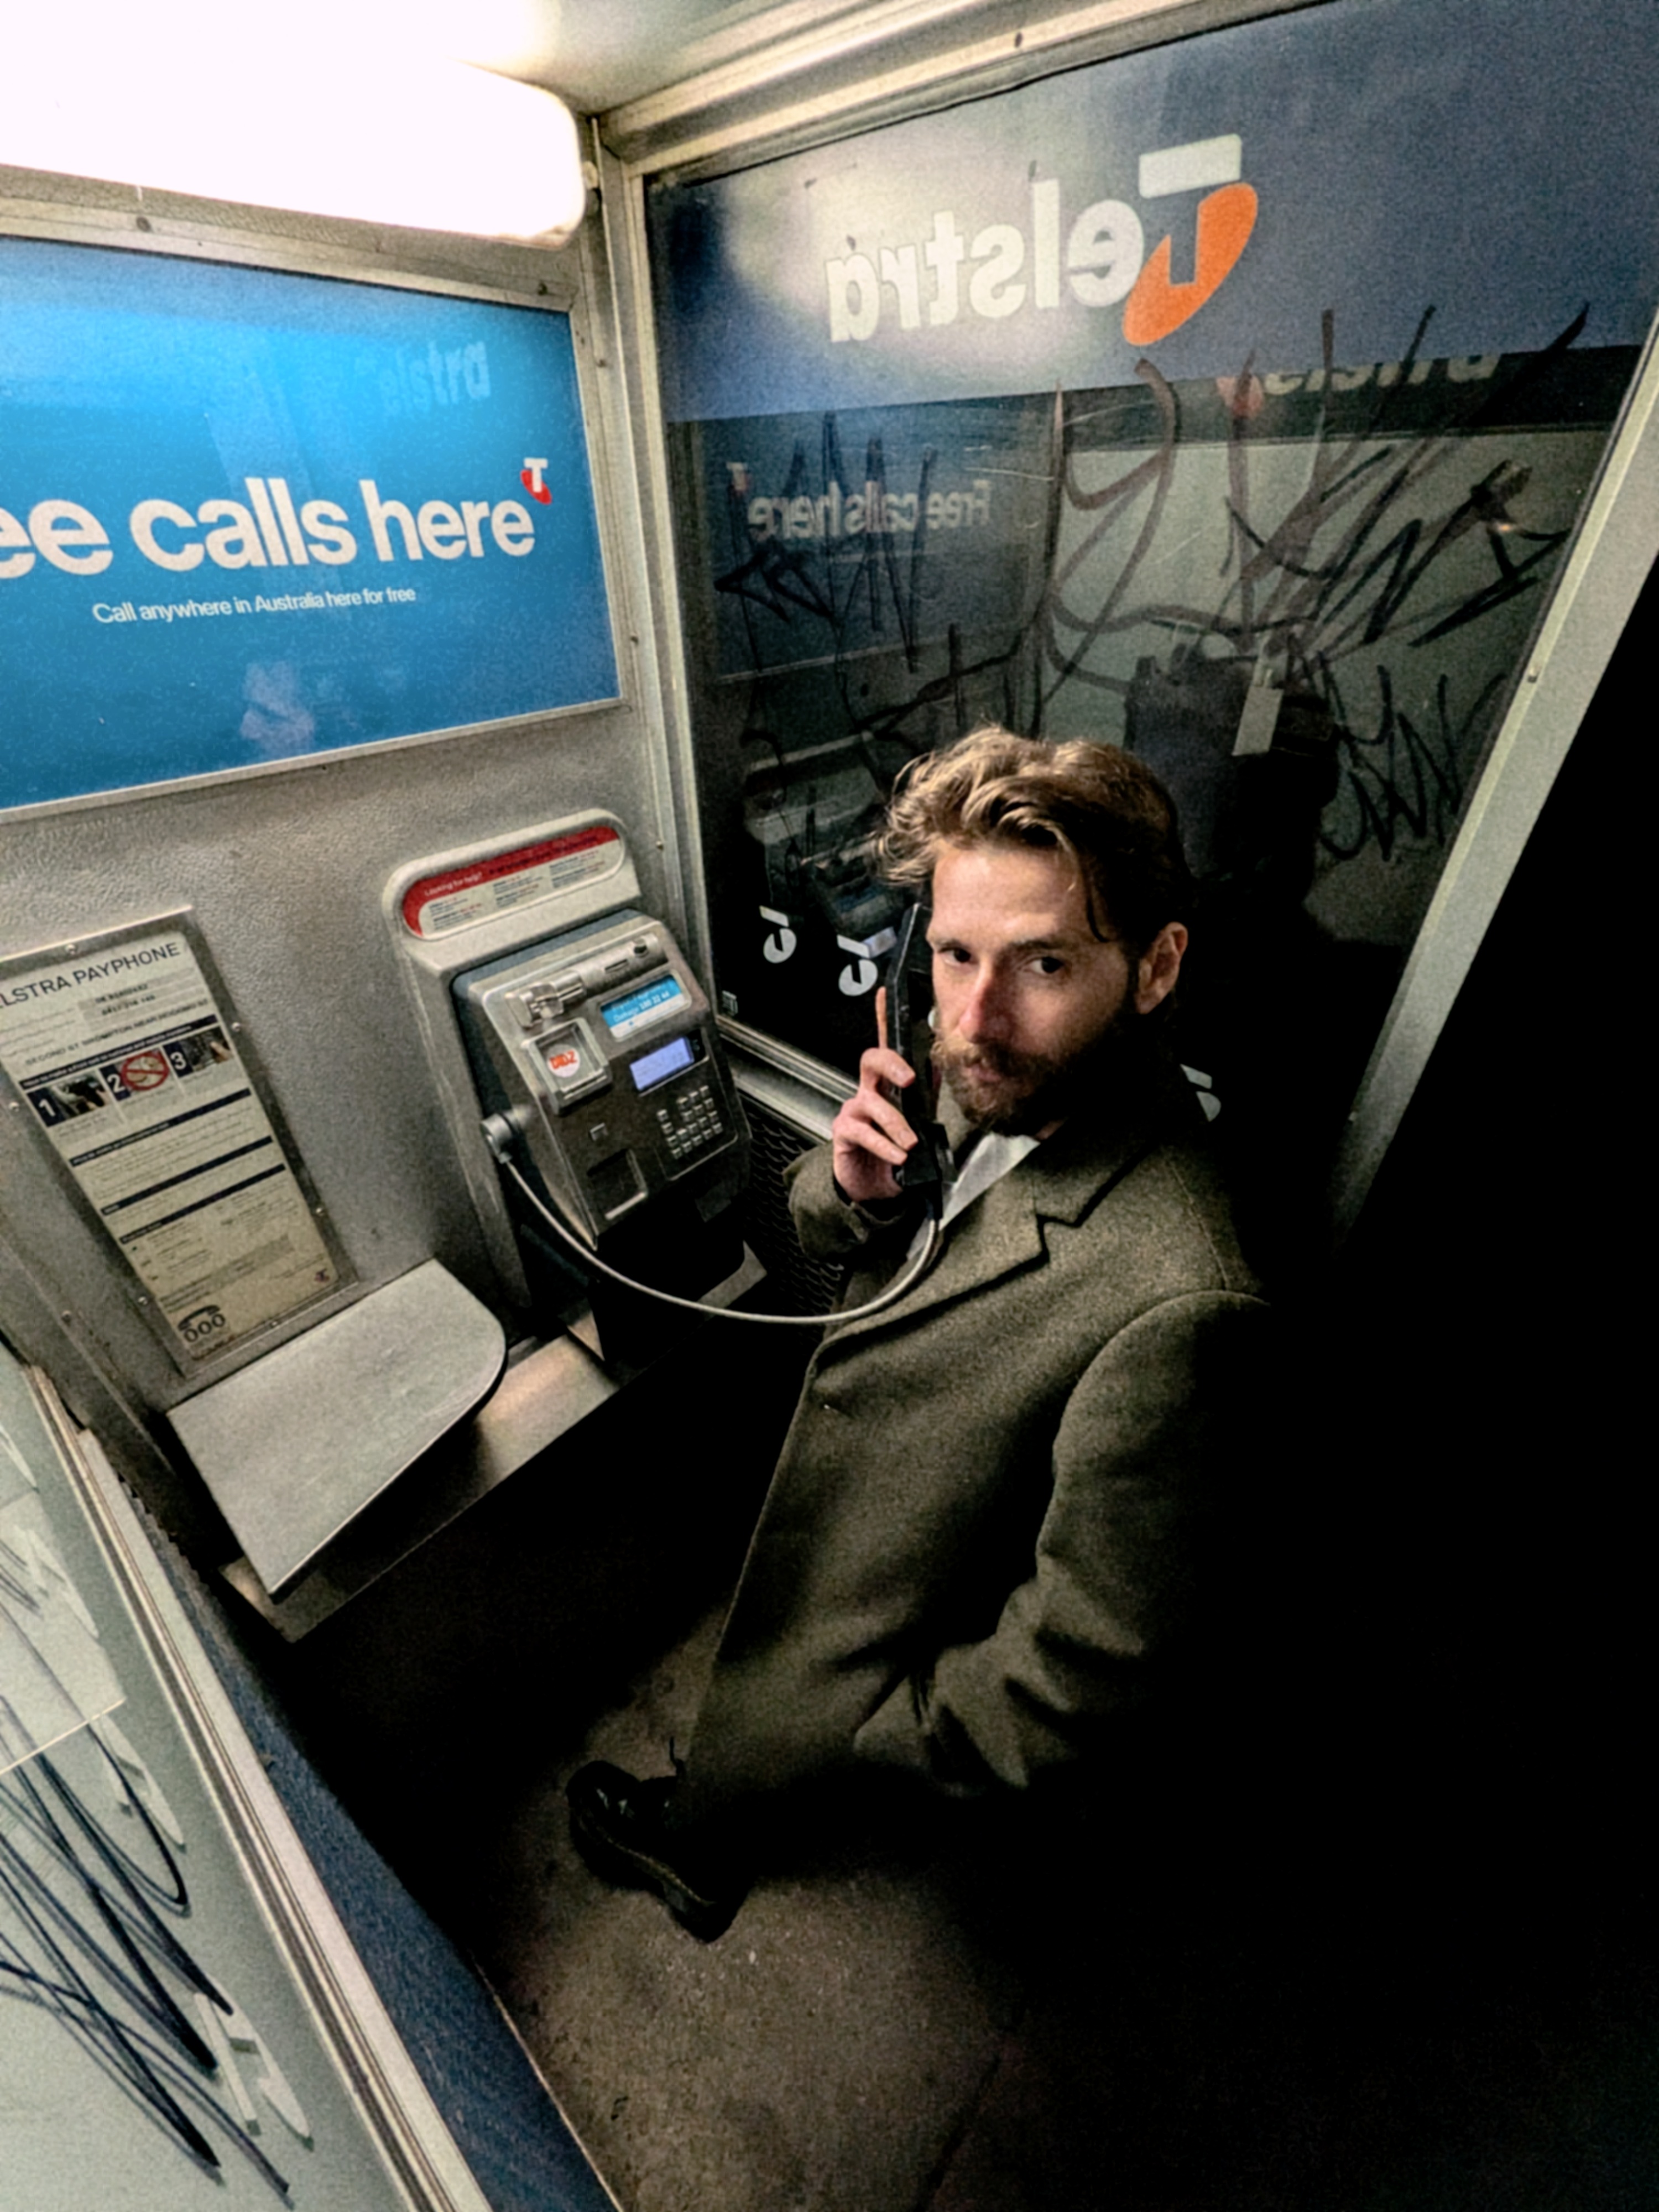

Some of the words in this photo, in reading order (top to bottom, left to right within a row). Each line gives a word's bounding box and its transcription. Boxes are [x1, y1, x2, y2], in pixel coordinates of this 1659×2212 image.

[129, 477, 358, 572] calls
[358, 479, 535, 562] here
[92, 602, 137, 624] Call
[139, 596, 232, 623] anywhere
[233, 595, 252, 614] in
[254, 592, 325, 613] Australia
[326, 590, 362, 608] here
[363, 587, 385, 604] for
[386, 585, 416, 603] free
[0, 975, 72, 1006] LSTRA
[72, 942, 180, 985] PAYPHONE
[170, 1052, 187, 1070] 3
[107, 1074, 126, 1093] 2
[39, 1102, 55, 1118] 1
